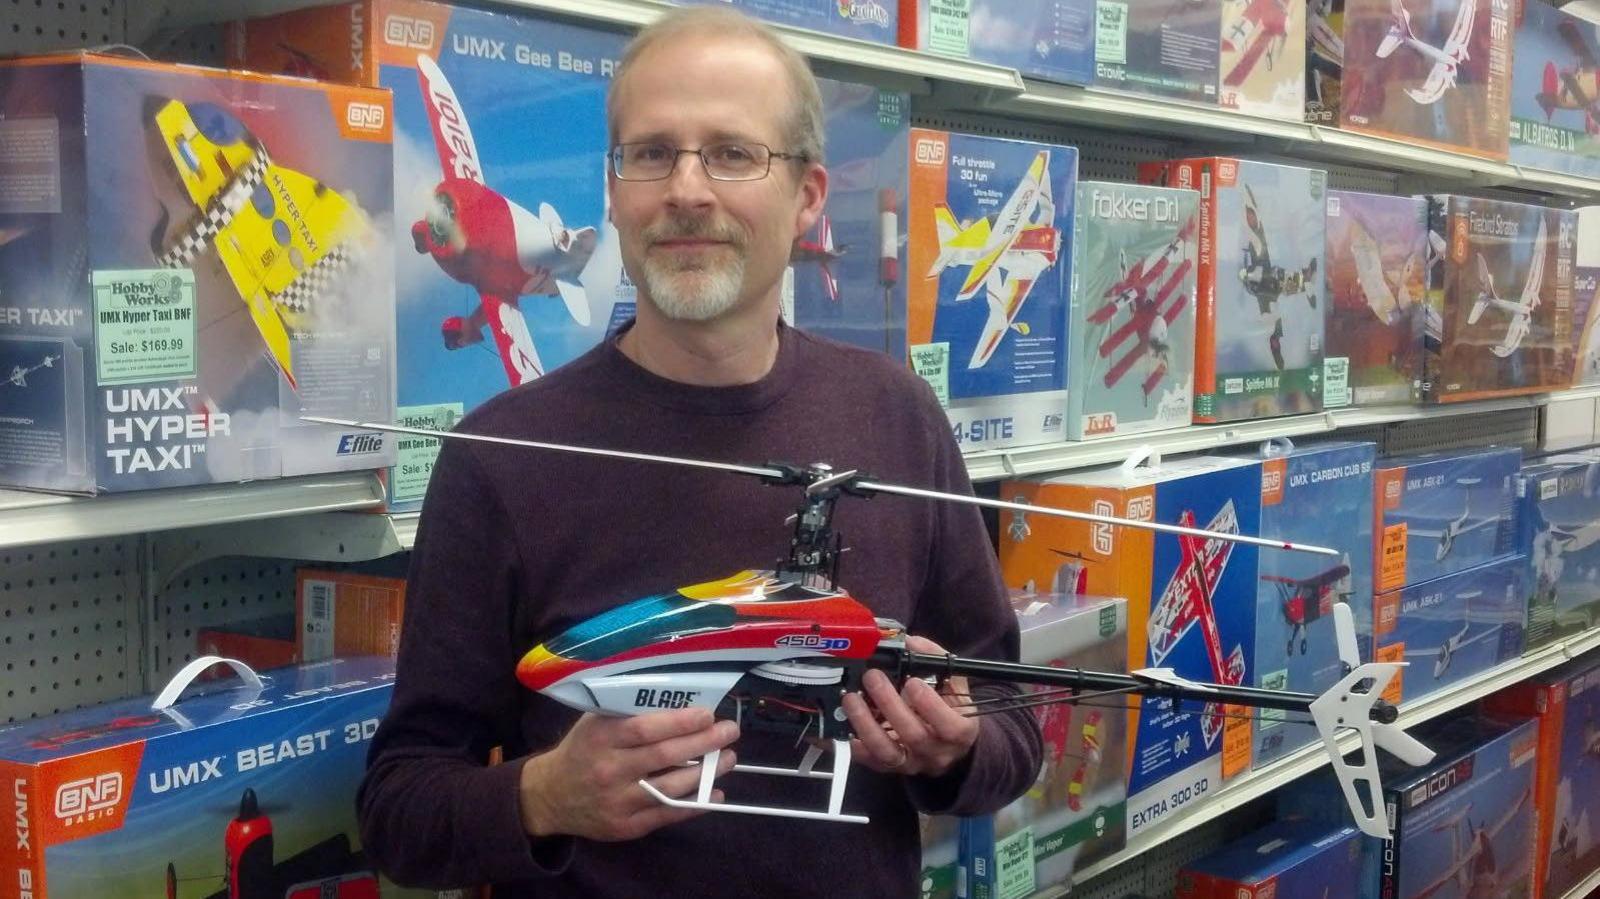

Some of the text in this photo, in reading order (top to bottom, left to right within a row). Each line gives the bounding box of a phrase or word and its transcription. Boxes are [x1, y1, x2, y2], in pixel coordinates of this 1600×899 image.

[350, 4, 364, 71] UMX
[384, 15, 434, 50] BNF
[453, 34, 507, 61] UMX
[514, 45, 552, 69] Gee
[558, 52, 594, 74] Bee
[348, 103, 384, 129] BNF
[915, 139, 946, 165] BNF
[952, 156, 966, 166] Full
[1179, 165, 1193, 190] BN
[272, 175, 318, 252] HYPER TAXI
[111, 283, 156, 296] Hobby
[125, 294, 170, 306] Works
[100, 308, 191, 324] UMX Hyper Taxi BNF
[111, 338, 183, 354] Sale: $169.99
[107, 413, 231, 444] HYPER
[404, 416, 436, 427] Hobby
[1290, 474, 1308, 487] UMX
[1311, 468, 1343, 482] CARBON
[1344, 464, 1360, 476] CUB
[1407, 479, 1421, 490] UMX
[1128, 495, 1153, 521] BNF
[635, 688, 697, 709] BLADE
[237, 728, 332, 773] BEAST
[344, 718, 382, 745] 3D
[55, 772, 122, 820] BNF
[1132, 778, 1209, 830] EXTRA 300 3D
[14, 778, 31, 851] UMX
[65, 808, 114, 827] BASIC
